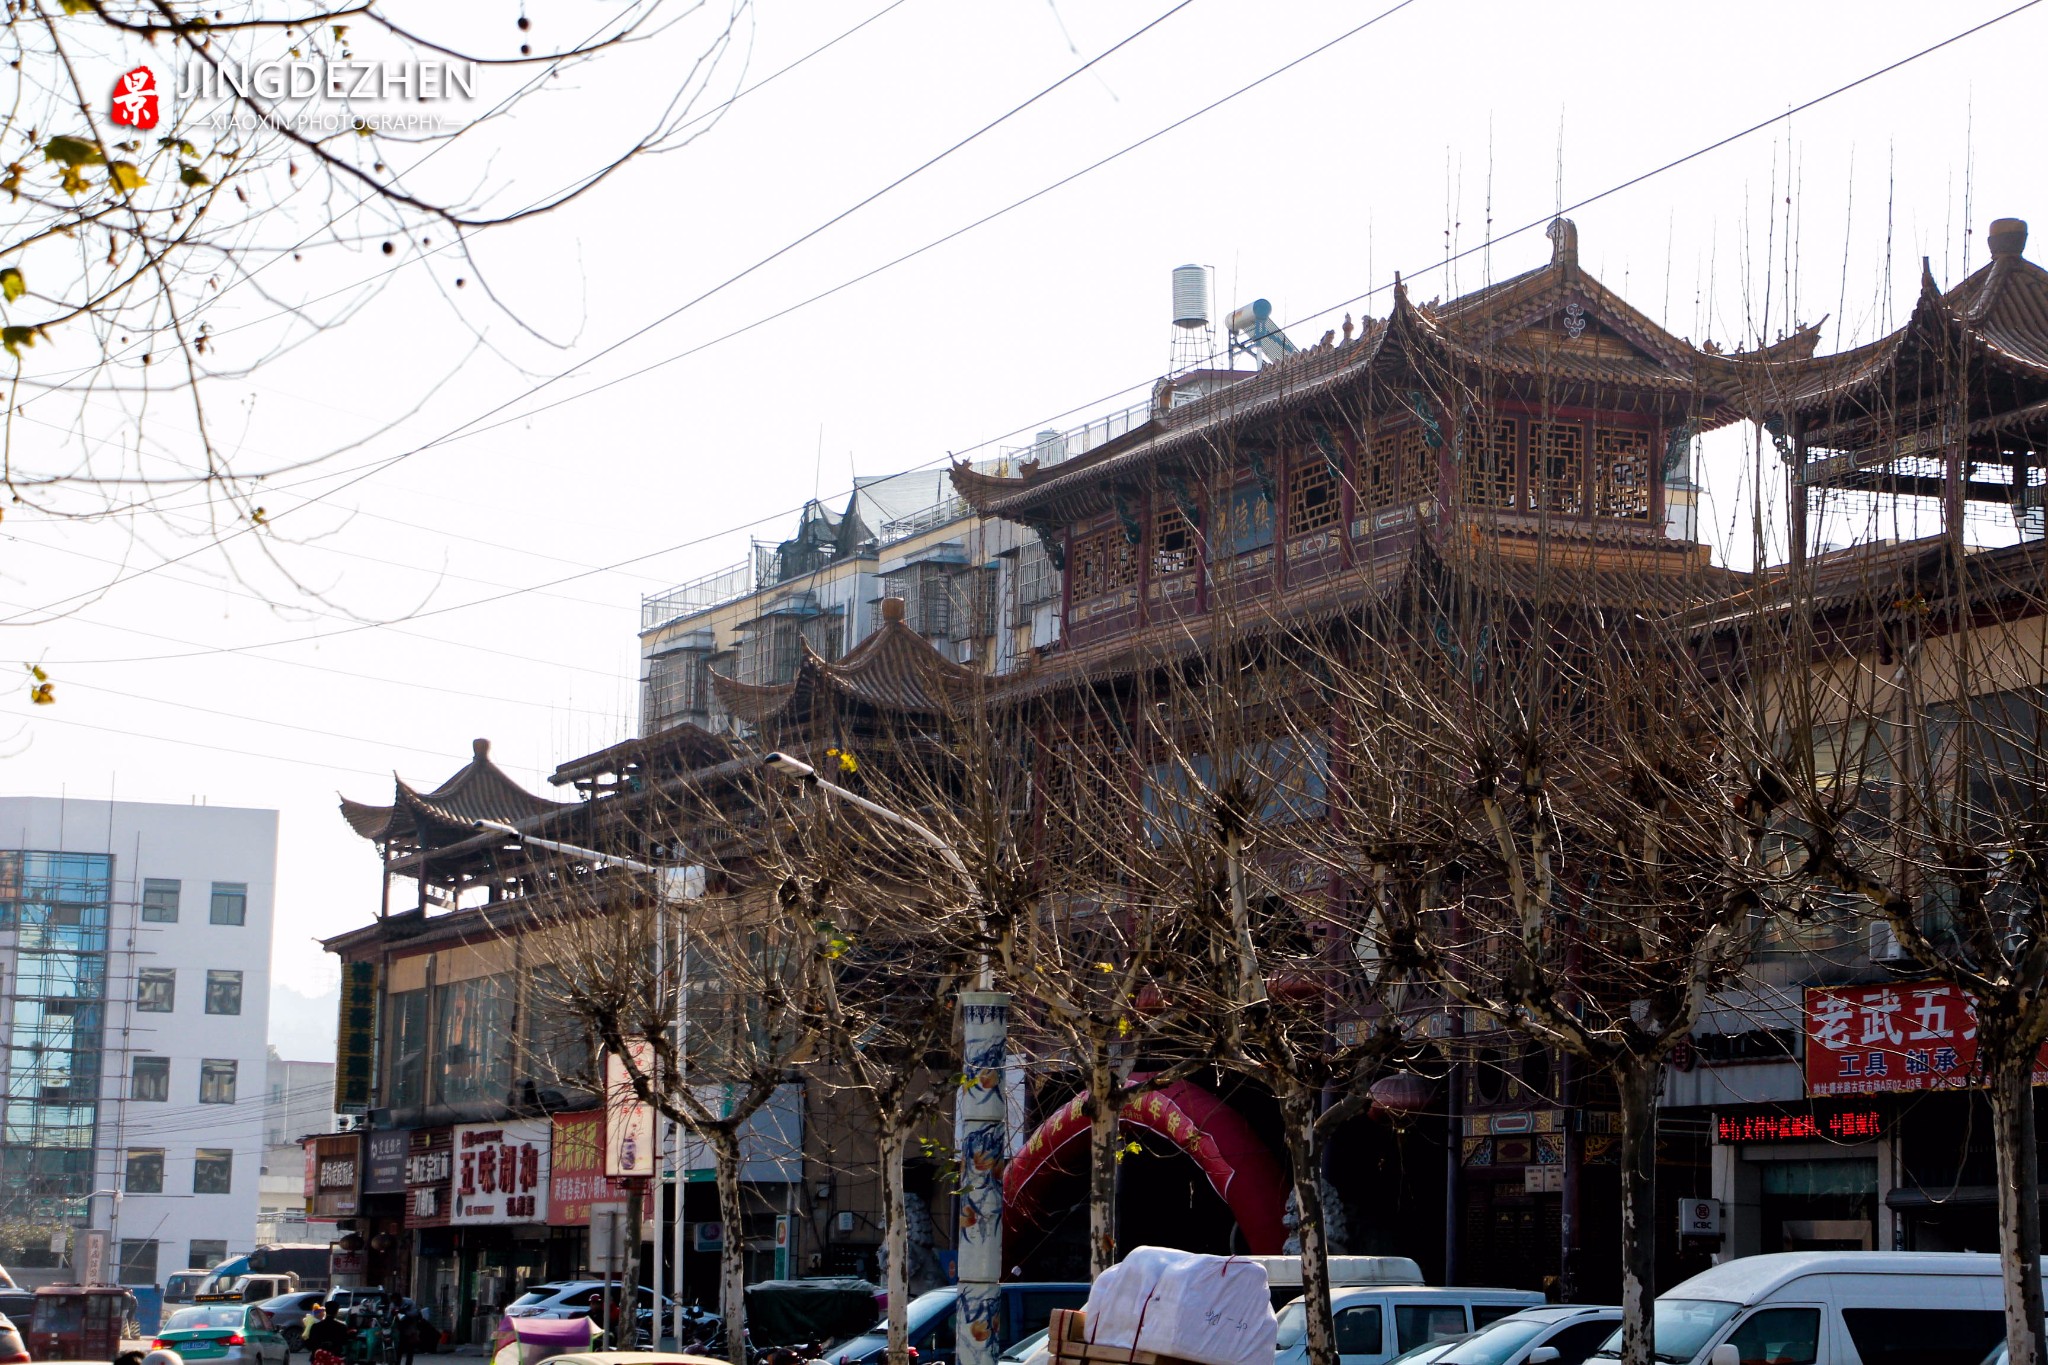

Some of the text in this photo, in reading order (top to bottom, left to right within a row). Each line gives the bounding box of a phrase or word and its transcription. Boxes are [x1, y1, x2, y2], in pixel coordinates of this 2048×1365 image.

[1838, 1052, 1888, 1077] 工具
[1905, 1047, 1959, 1074] 轴承
[1693, 1221, 1712, 1229] ICBC
